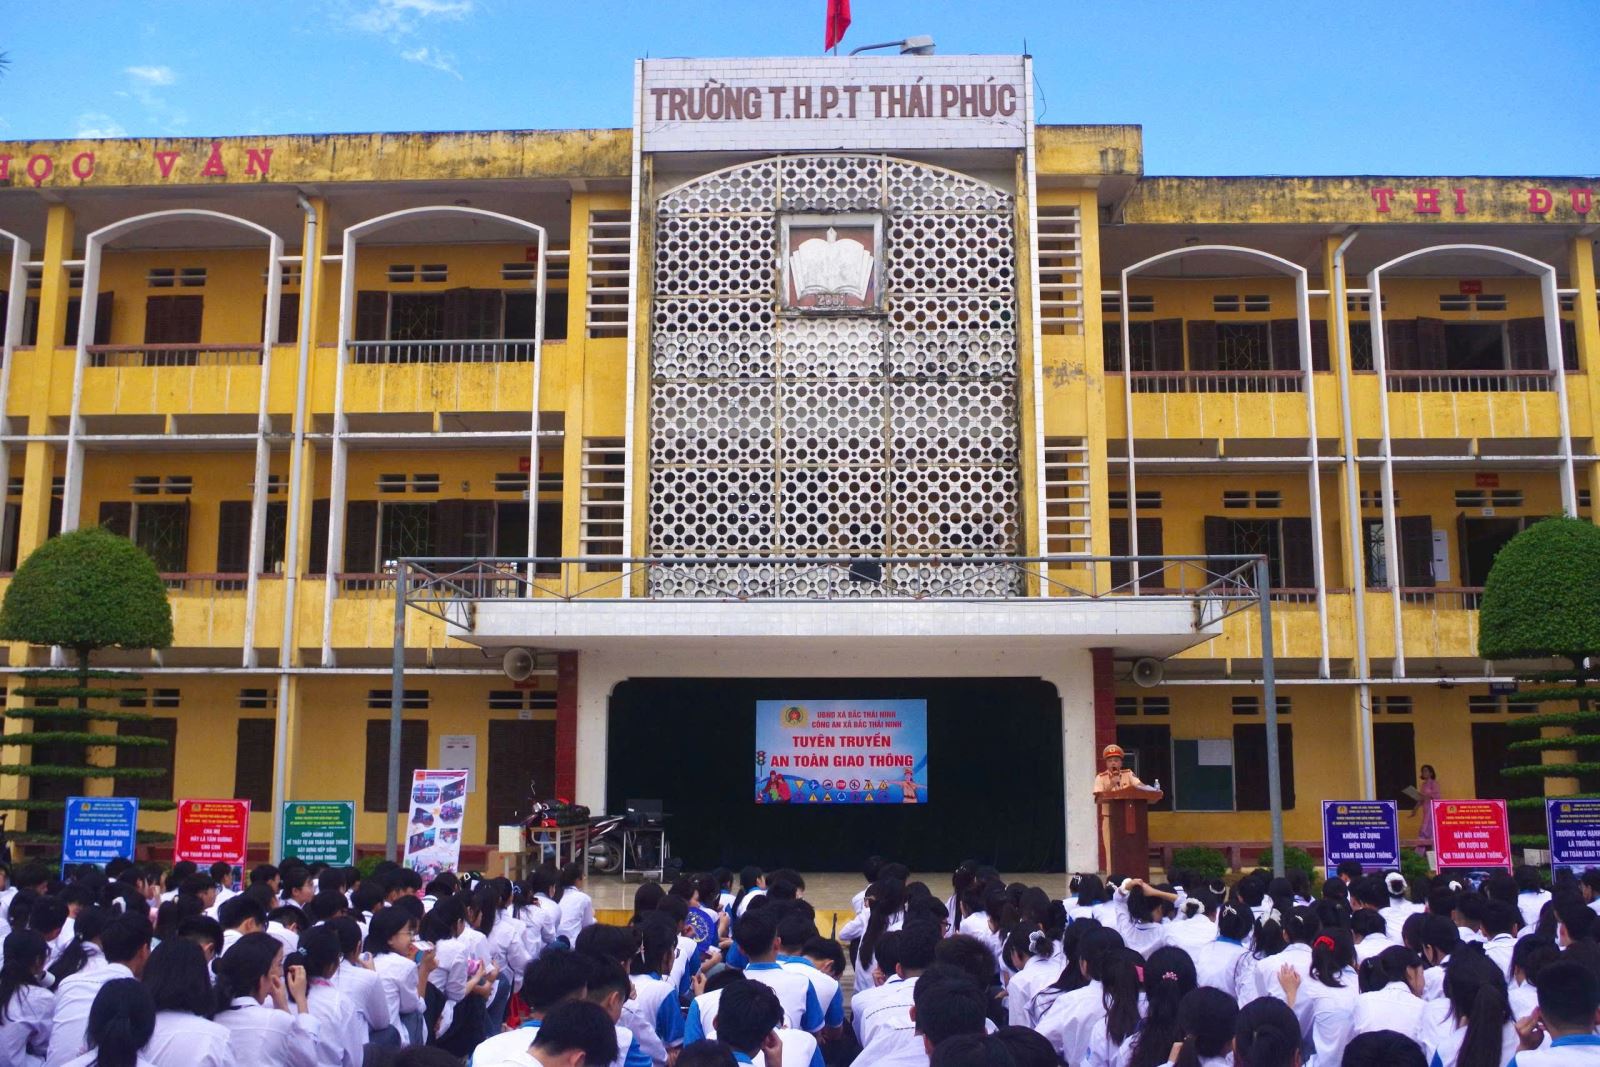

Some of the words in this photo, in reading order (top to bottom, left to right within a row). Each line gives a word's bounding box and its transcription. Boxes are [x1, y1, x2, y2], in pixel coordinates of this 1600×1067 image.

[651, 78, 761, 121] TRƯỜNG
[869, 75, 933, 119] THÁI
[941, 75, 1017, 118] PHÚC
[1371, 188, 1468, 213] THI
[880, 710, 896, 718] NINH
[792, 734, 835, 748] TUYÊN
[771, 755, 789, 767] AN
[793, 753, 829, 767] TOÀN
[833, 755, 865, 767] GIAO
[869, 753, 913, 767] THÔNG
